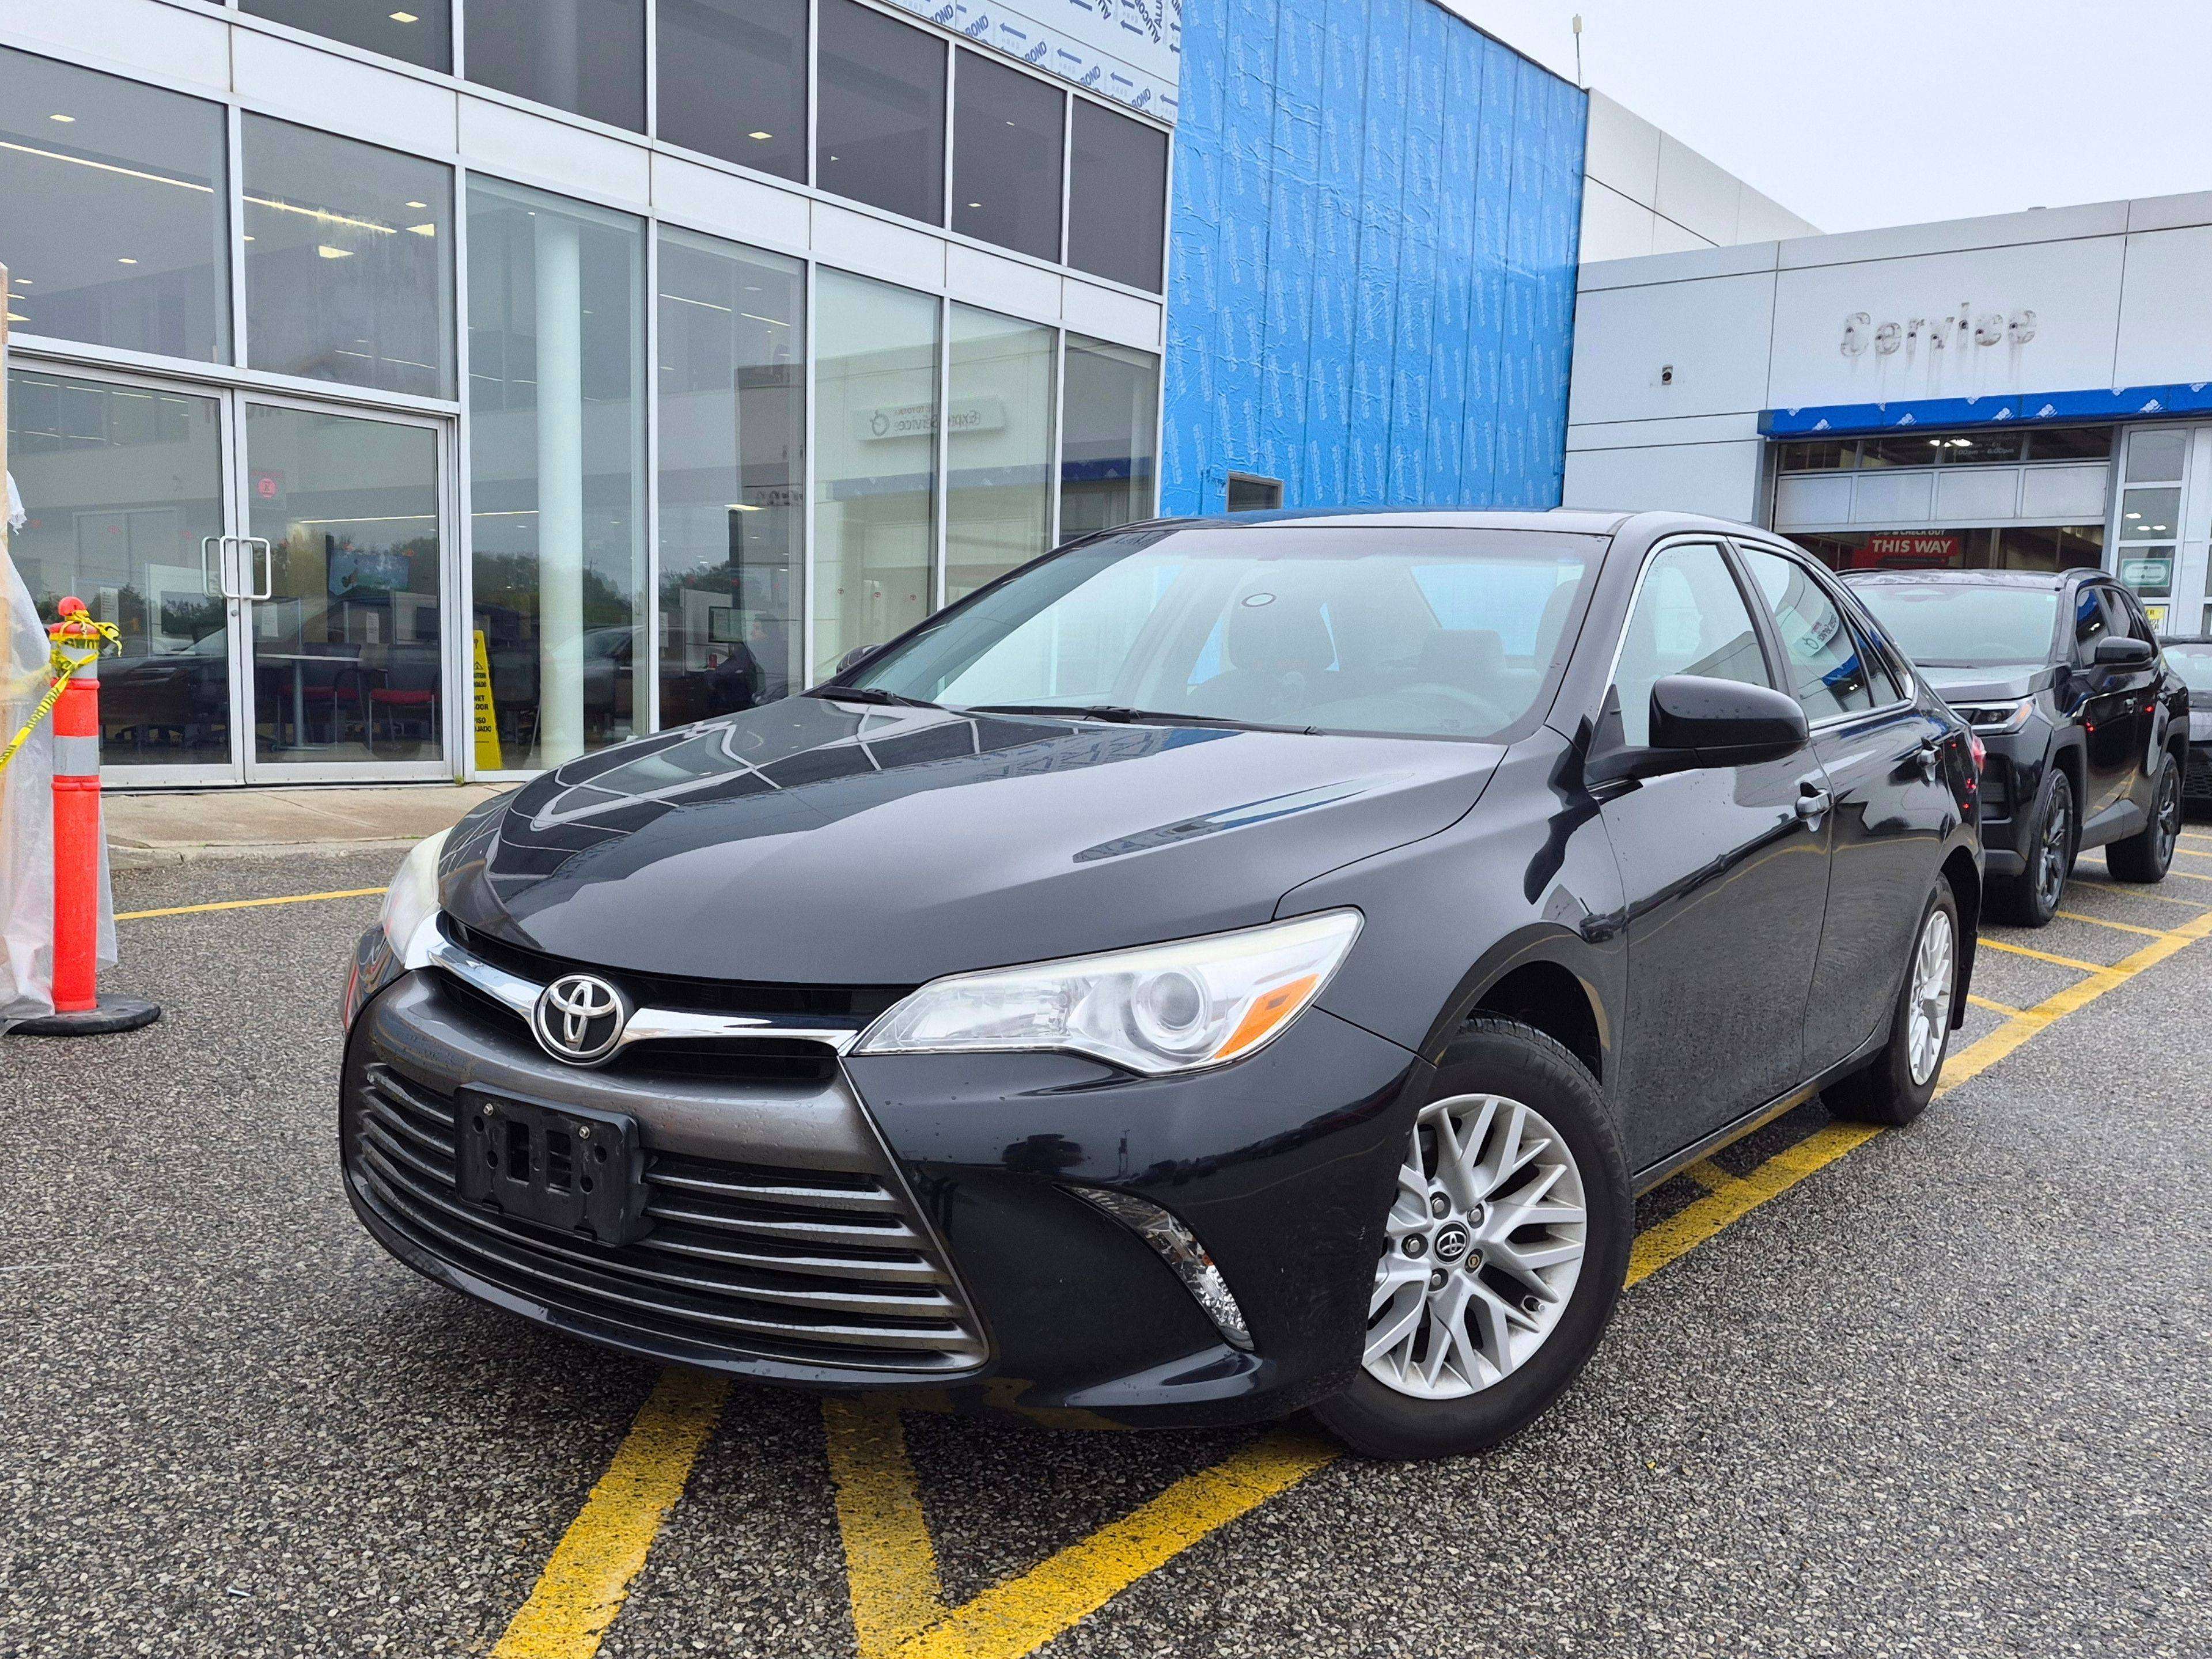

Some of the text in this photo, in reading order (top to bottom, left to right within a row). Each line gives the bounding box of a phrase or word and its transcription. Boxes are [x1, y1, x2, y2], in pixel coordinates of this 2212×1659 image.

[1840, 302, 2037, 357] Service
[1872, 539, 1952, 554] THIS WAY
